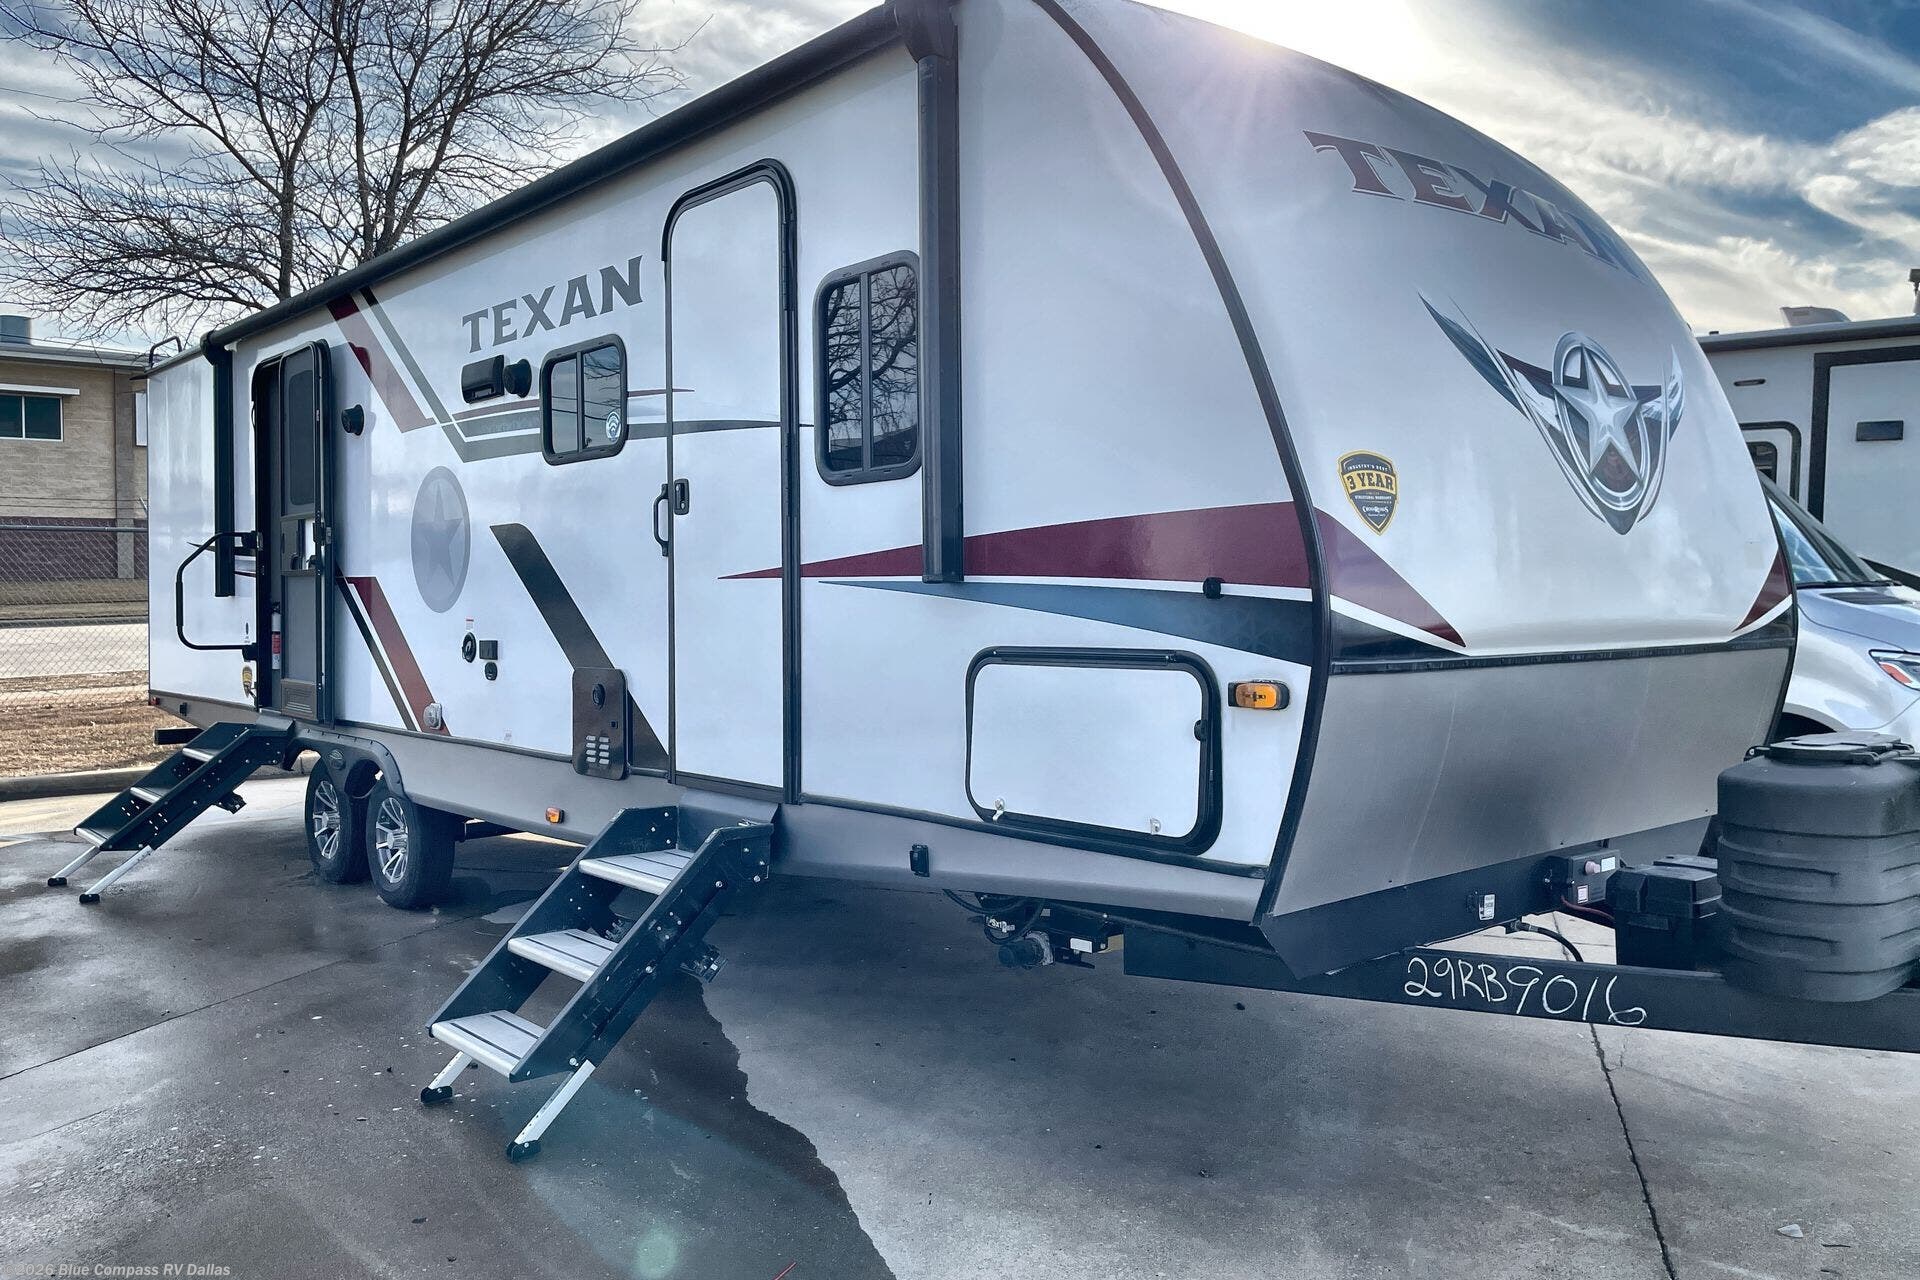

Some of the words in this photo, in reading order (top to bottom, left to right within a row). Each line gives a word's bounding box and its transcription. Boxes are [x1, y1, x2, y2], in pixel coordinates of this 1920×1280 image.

[1303, 130, 1649, 286] TEXAN
[462, 254, 643, 353] TEXAN
[1346, 475, 1357, 490] 3
[1357, 472, 1394, 491] YEAR
